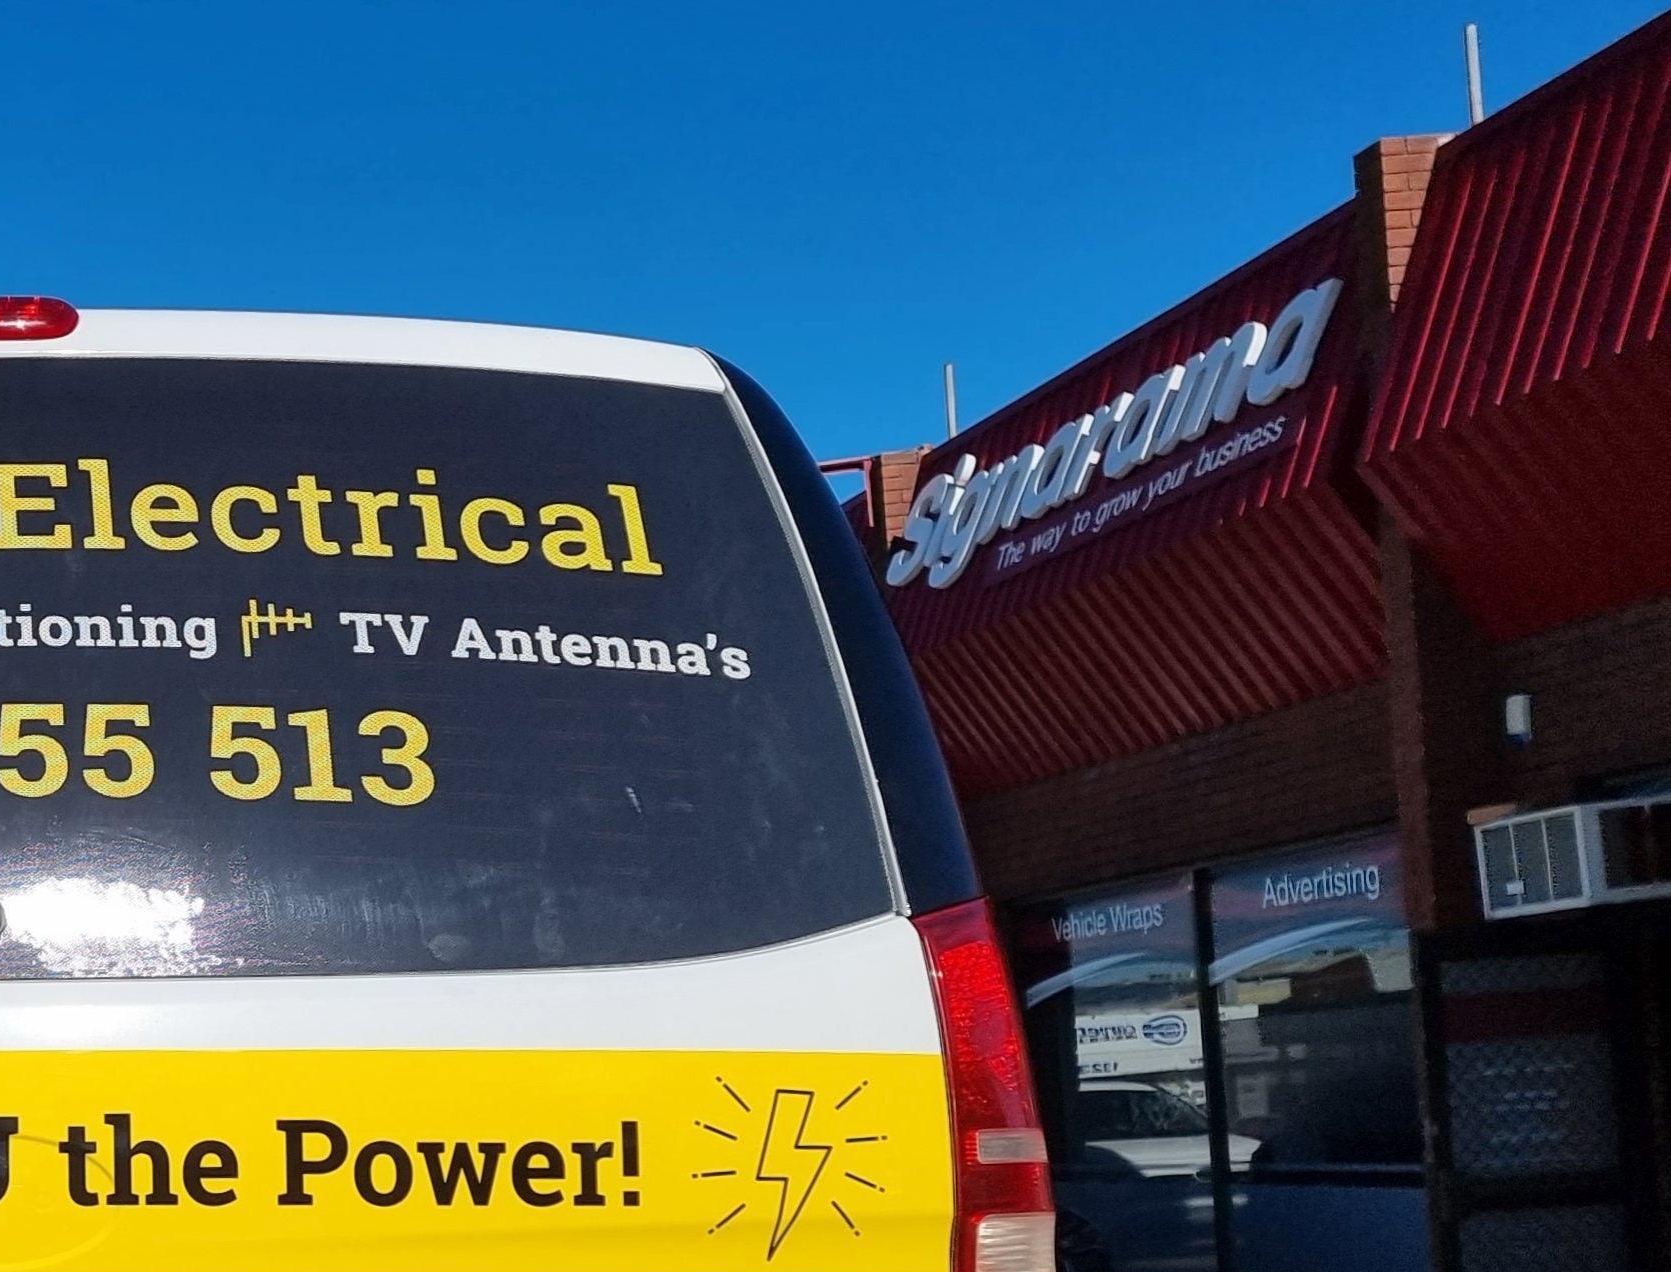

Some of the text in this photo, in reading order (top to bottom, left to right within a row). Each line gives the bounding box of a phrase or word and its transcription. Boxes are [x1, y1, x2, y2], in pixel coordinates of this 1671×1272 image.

[886, 277, 1344, 590] Signarama
[996, 414, 1288, 570] The way to grow your business
[339, 612, 429, 658] TV
[451, 618, 752, 681] Antenna's
[209, 702, 436, 806] 513
[1050, 901, 1164, 942] Vehicle Wraps
[1261, 862, 1380, 909] Advertising
[59, 1113, 238, 1206] the
[276, 1119, 641, 1208] Power!
